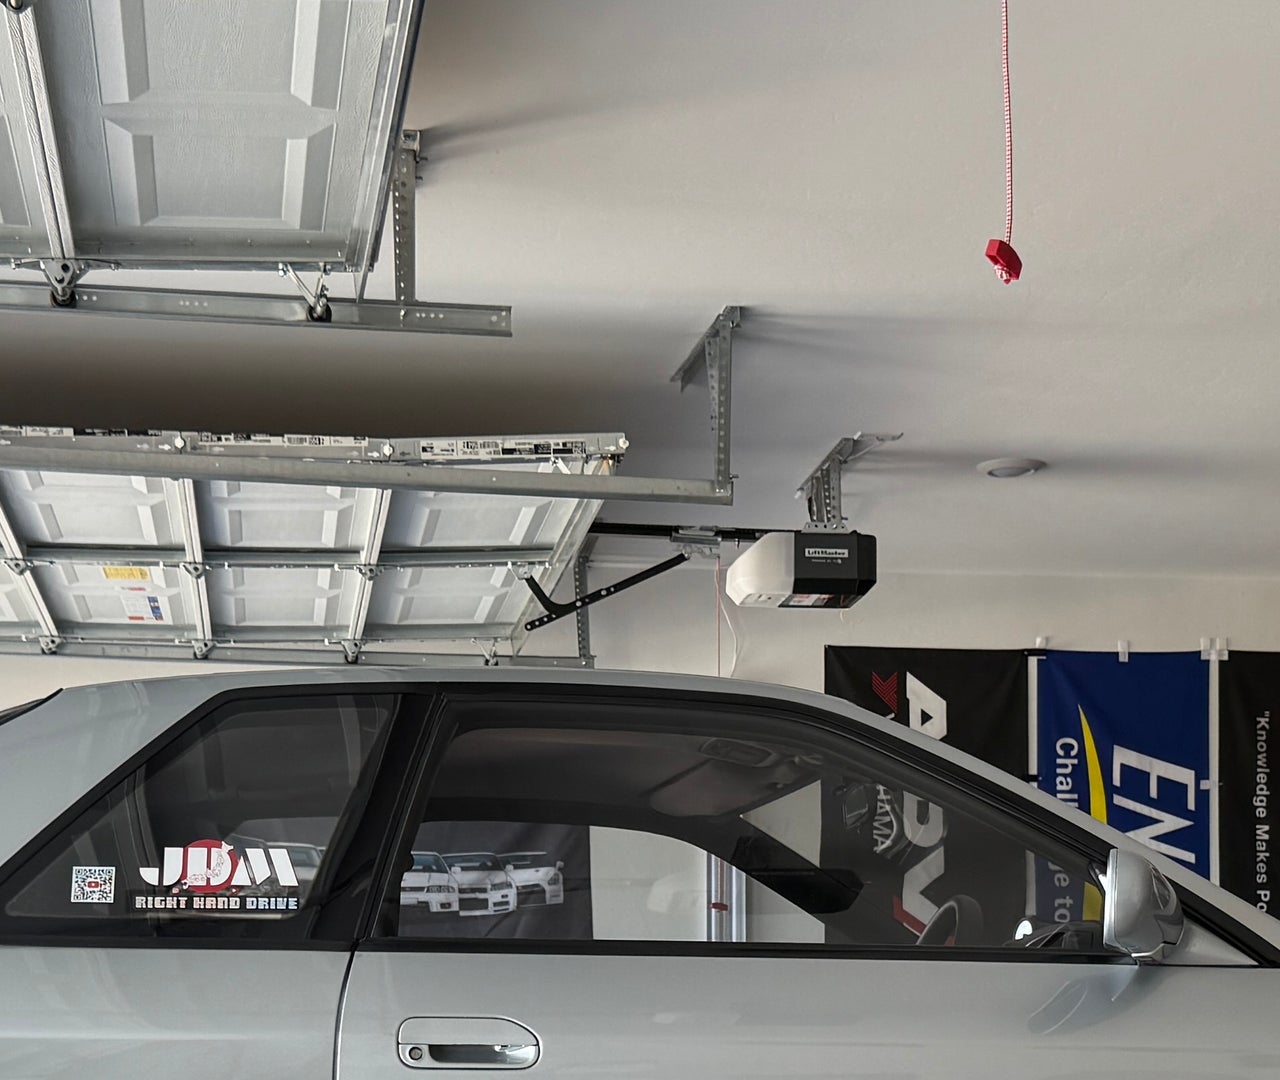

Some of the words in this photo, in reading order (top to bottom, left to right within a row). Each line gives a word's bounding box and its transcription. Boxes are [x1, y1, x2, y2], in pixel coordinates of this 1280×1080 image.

[139, 847, 299, 887] JDM
[1255, 824, 1270, 884] Makes
[135, 896, 188, 909] RIGHT
[193, 897, 240, 910] HAND
[246, 898, 298, 910] DRIVE
